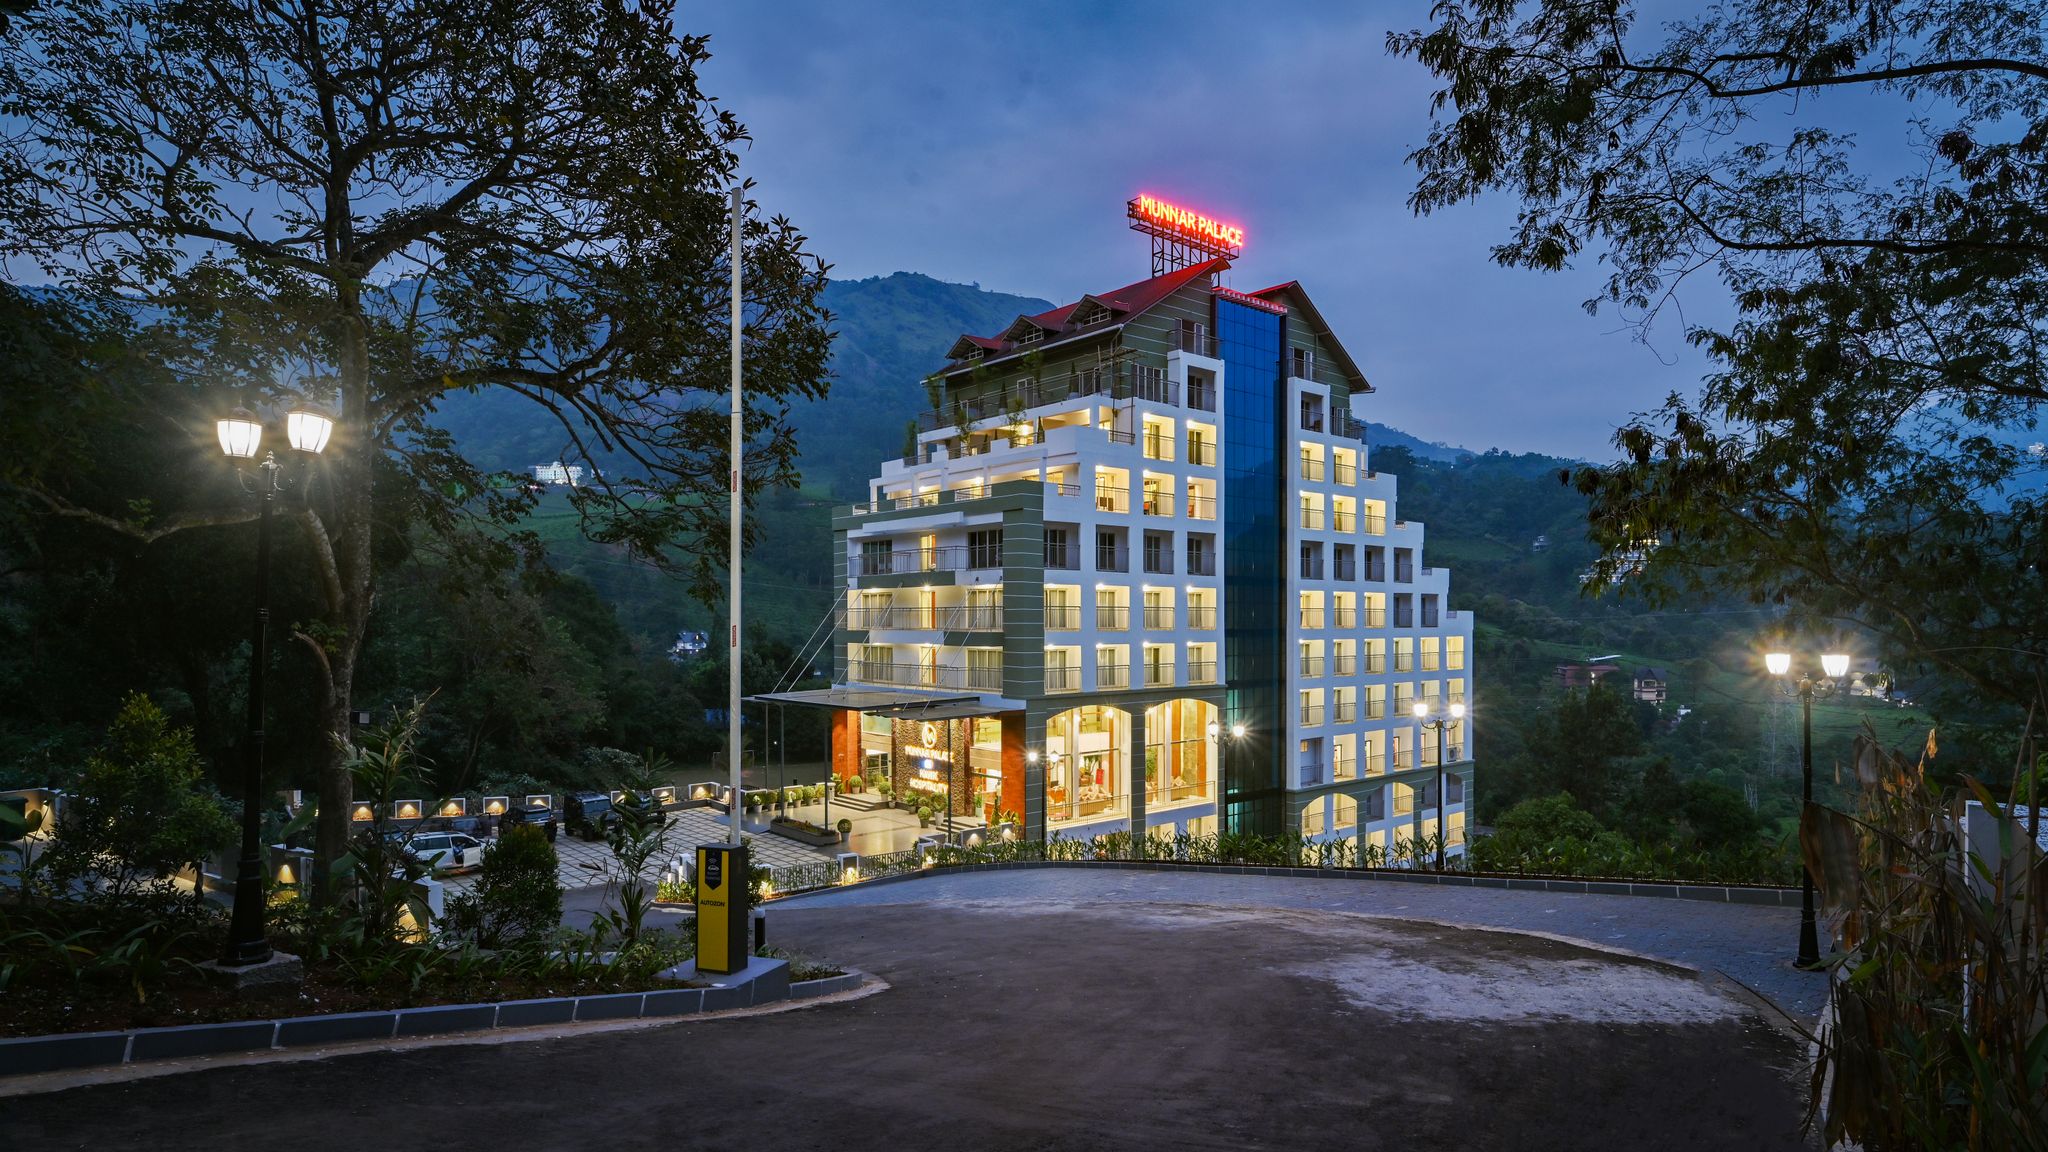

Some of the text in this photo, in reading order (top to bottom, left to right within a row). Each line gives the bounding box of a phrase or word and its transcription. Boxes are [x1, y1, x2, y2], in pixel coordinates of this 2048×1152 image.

[1140, 195, 1243, 246] MUNNAR PALACE
[909, 777, 948, 794] HOSPITALITY
